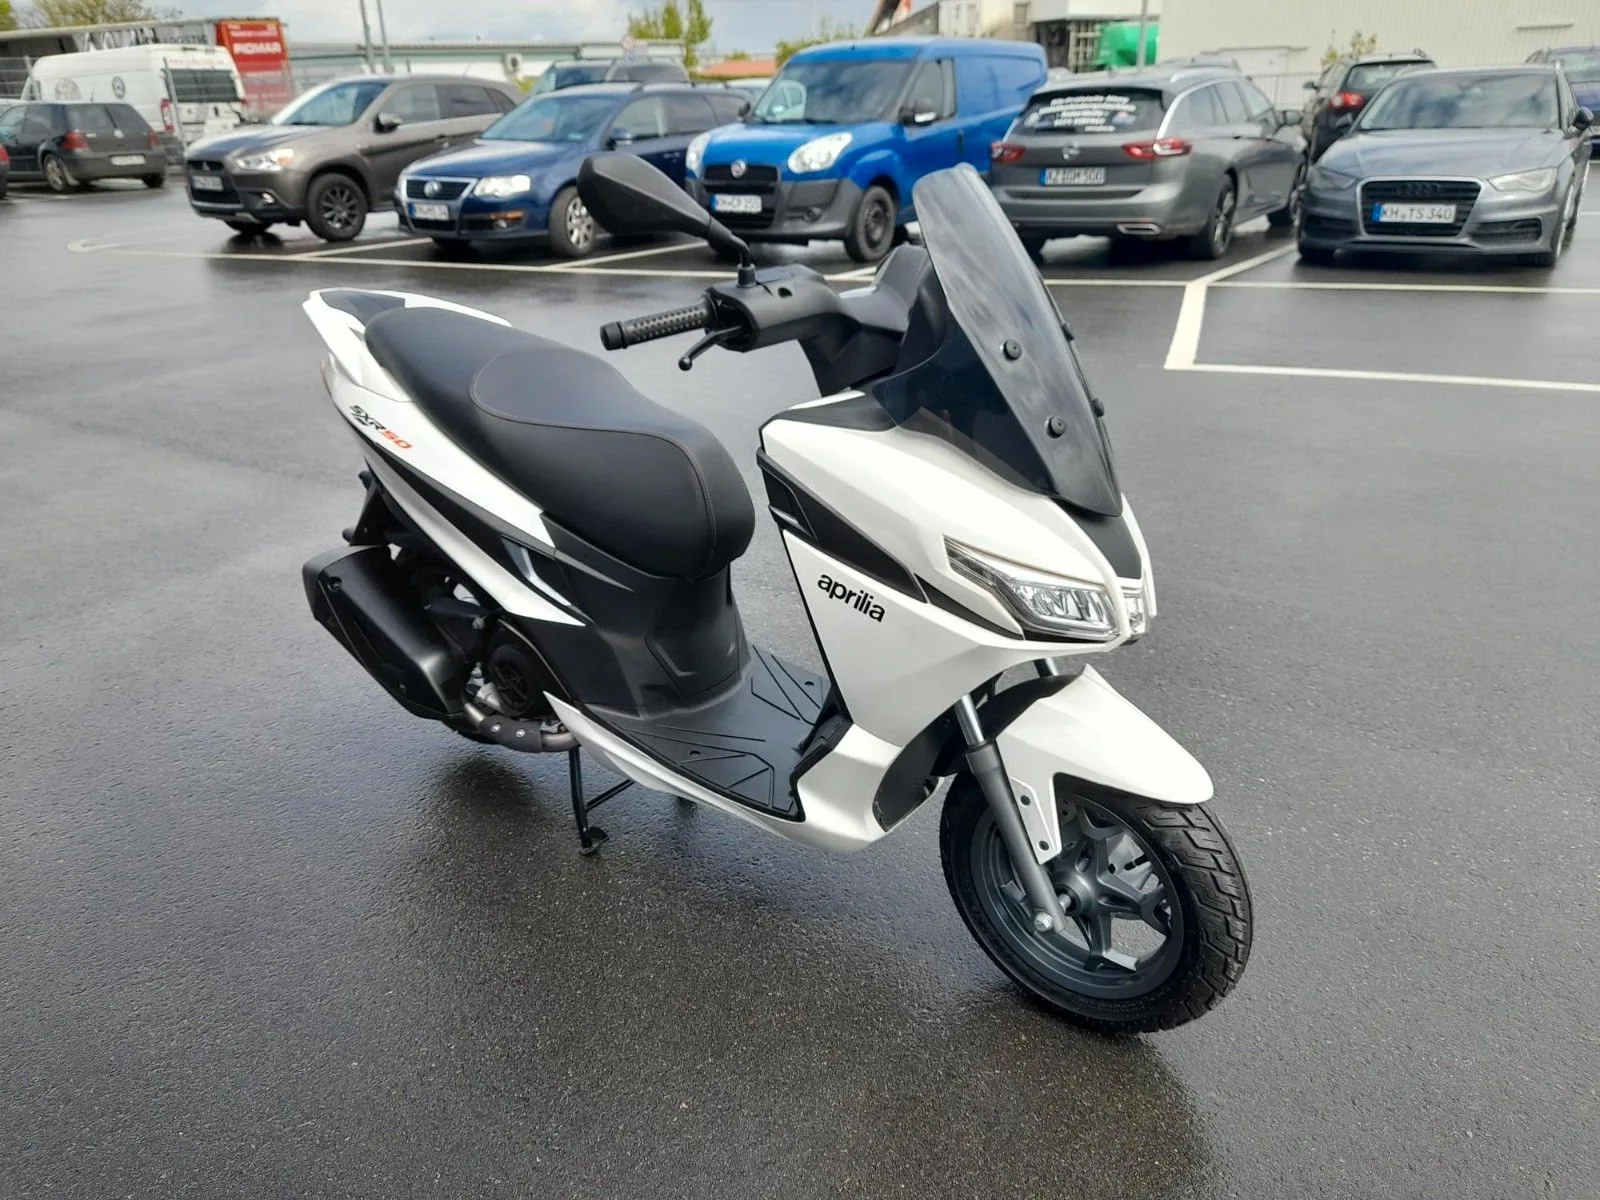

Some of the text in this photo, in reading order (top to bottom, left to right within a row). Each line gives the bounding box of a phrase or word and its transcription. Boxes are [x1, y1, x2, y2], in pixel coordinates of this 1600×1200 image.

[1428, 207, 1454, 220] 340
[350, 405, 413, 449] SXR50
[817, 574, 886, 623] aprilia
